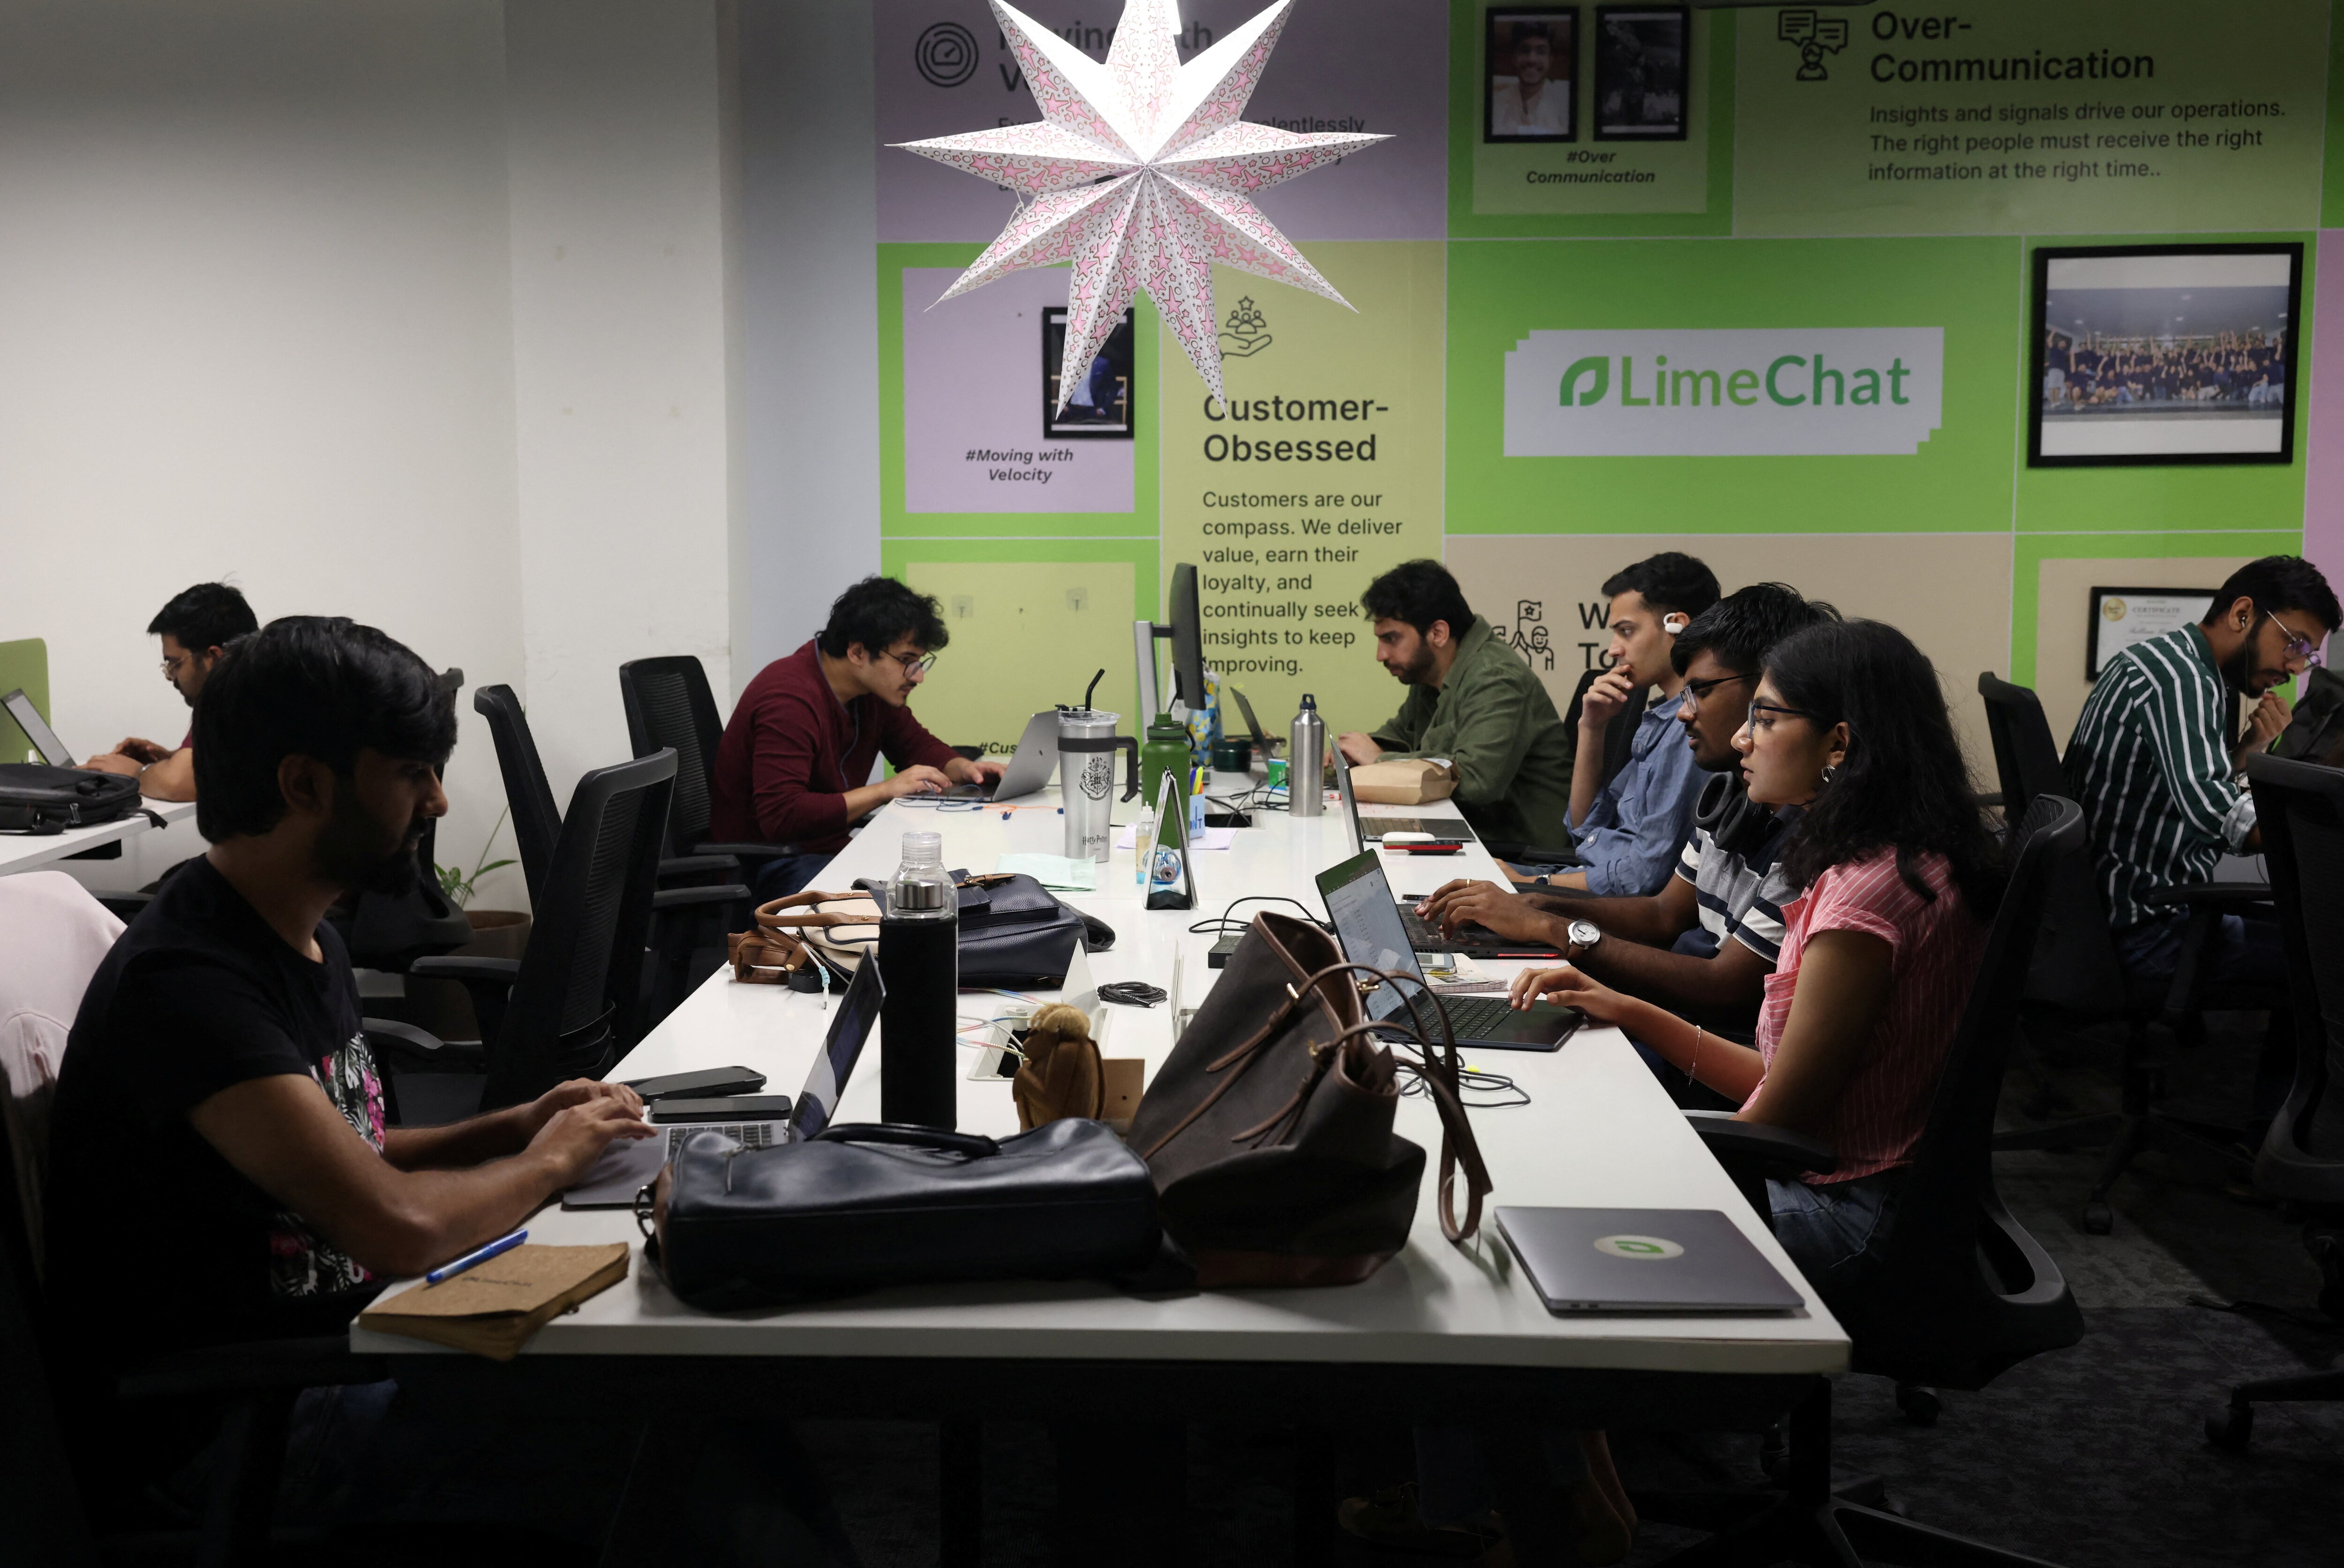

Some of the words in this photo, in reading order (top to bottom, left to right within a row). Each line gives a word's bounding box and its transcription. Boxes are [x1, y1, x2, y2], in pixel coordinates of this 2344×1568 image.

[1872, 11, 1972, 40] Over-
[1871, 48, 2154, 83] Communication
[1871, 105, 1949, 127] Insights
[1955, 105, 1992, 122] and
[1998, 103, 2068, 126] signals
[2075, 101, 2125, 120] drive
[2132, 105, 2165, 119] our
[2171, 99, 2285, 122] operations.
[1870, 135, 1907, 151] The
[1914, 134, 1959, 155] right
[1966, 133, 2034, 154] people
[2040, 133, 2090, 149] must
[2097, 130, 2170, 148] receive
[2177, 130, 2209, 147] the
[2216, 129, 2262, 150] right
[1567, 150, 1616, 163] #Over
[1526, 169, 1655, 183] Communication
[1869, 162, 1982, 180] information
[1988, 164, 2007, 179] at
[2013, 161, 2046, 179] the
[2053, 160, 2099, 182] right
[2106, 159, 2160, 177] time..
[1621, 354, 1910, 406] LimeChat
[1204, 395, 1388, 421] Customer-
[966, 449, 1033, 465] #Moving
[1039, 448, 1074, 461] with
[1204, 434, 1375, 462] Obsessed
[989, 468, 1052, 484] Velocity
[1203, 491, 1308, 507] Customers
[1315, 495, 1345, 507] are
[1351, 495, 1382, 507] our
[1202, 522, 1294, 539] compass.
[1301, 519, 1331, 535] We
[1337, 518, 1403, 534] deliver
[1203, 547, 1259, 565] value,
[1266, 550, 1308, 563] earn
[1315, 546, 1359, 562] their
[1203, 574, 1270, 594] loyalty,
[1277, 574, 1312, 590] and
[1203, 601, 1307, 621] continually
[1315, 601, 1359, 617] seek
[1203, 629, 1278, 649] insights
[1284, 630, 1303, 645] to
[1309, 629, 1355, 648] keep
[1208, 656, 1303, 676] mproving.
[1082, 836, 1096, 846] Harry
